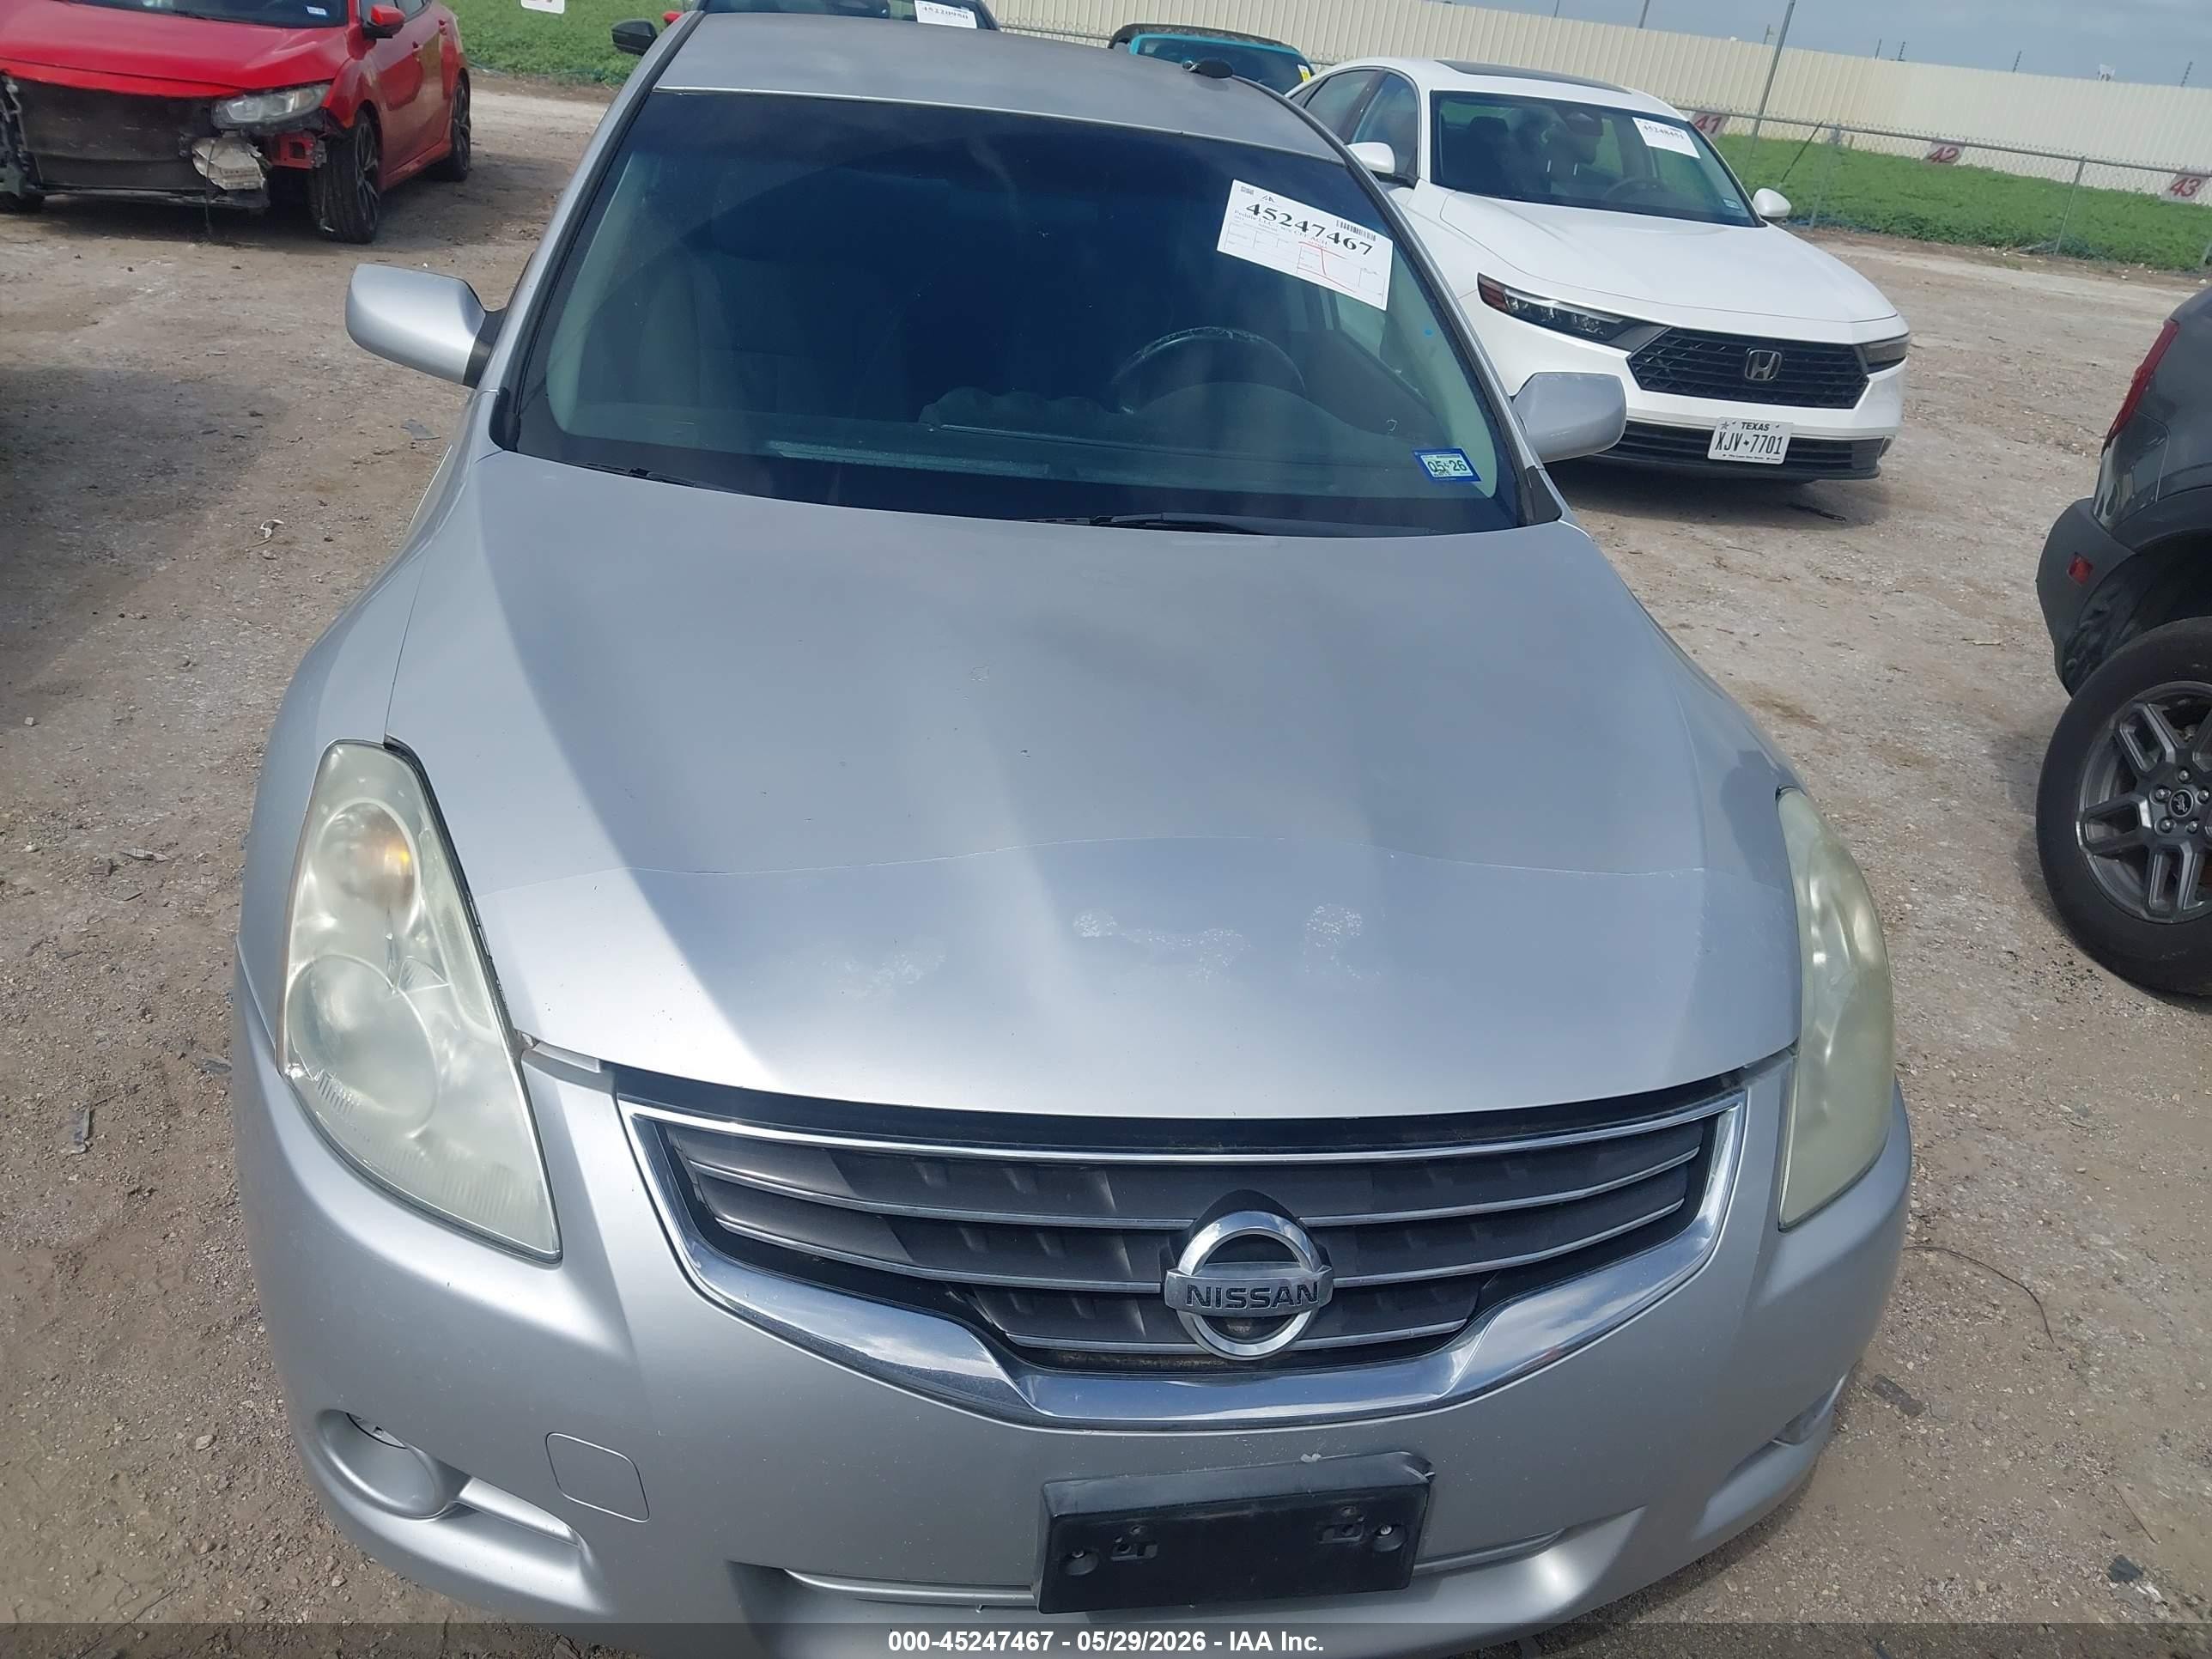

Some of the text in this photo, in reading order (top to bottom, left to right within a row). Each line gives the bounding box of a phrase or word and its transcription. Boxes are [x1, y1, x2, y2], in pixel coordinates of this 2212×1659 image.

[1694, 115, 1723, 134] 41
[1927, 146, 1960, 164] 42
[2170, 177, 2202, 197] 43
[1246, 203, 1374, 256] 45247467
[1741, 422, 1771, 432] TEXAS
[1185, 1281, 1319, 1310] NISSAN
